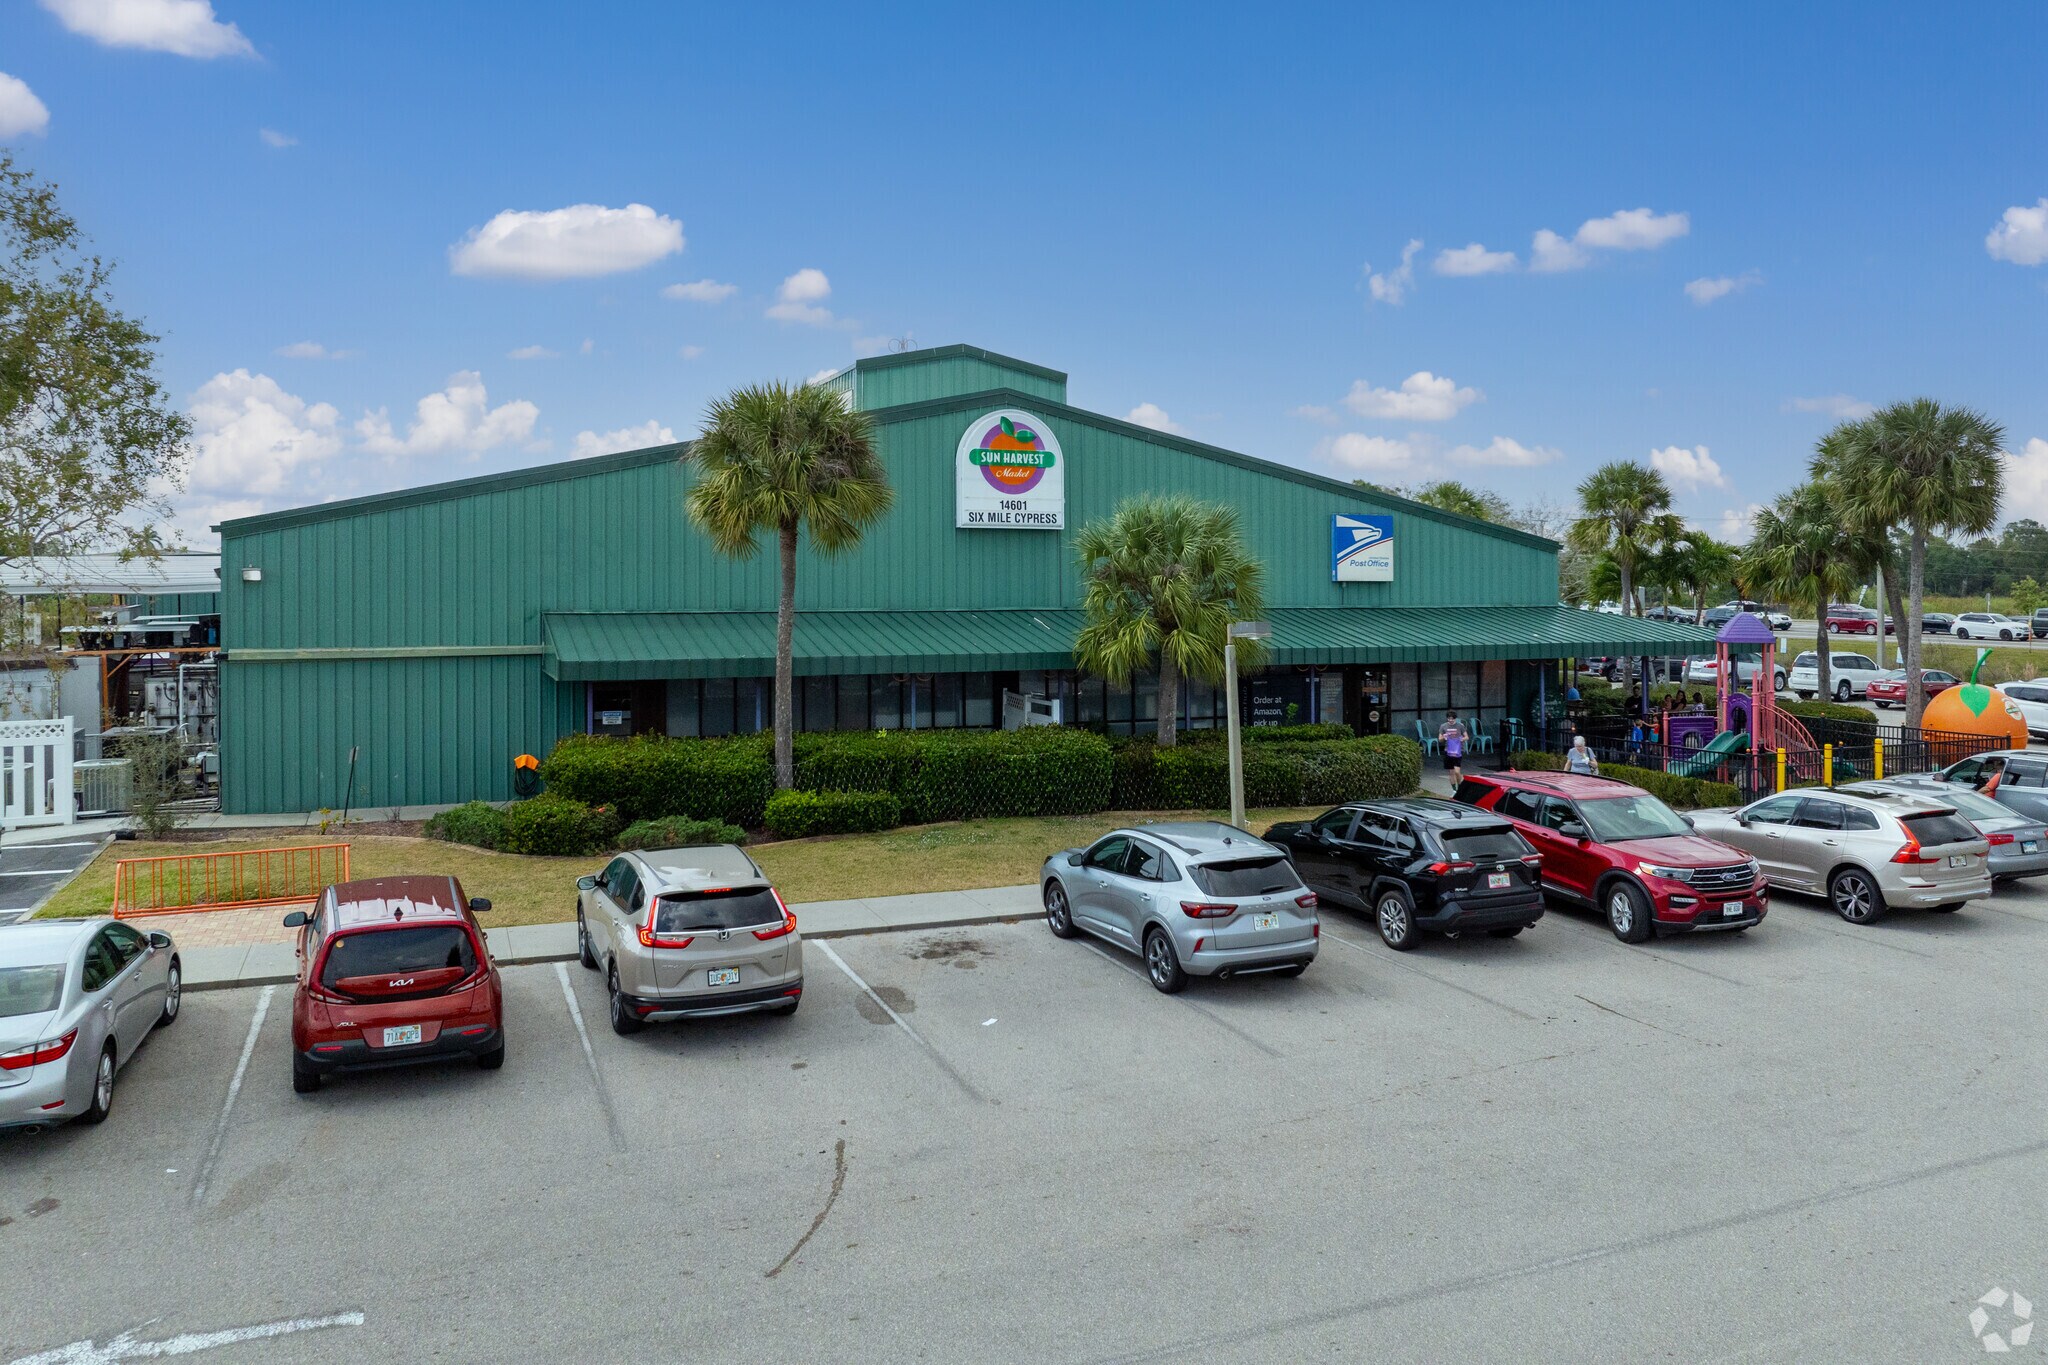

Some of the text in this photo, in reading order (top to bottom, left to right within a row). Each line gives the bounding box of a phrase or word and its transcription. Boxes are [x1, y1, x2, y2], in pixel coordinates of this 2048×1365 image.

[981, 451, 1045, 465] SUN HARVEST
[995, 467, 1030, 478] Market
[1000, 500, 1027, 511] 14601
[968, 511, 1058, 524] SIX MILE CYPRESS
[1368, 560, 1389, 568] Office
[1253, 696, 1282, 704] Order at
[1253, 719, 1267, 727] pick
